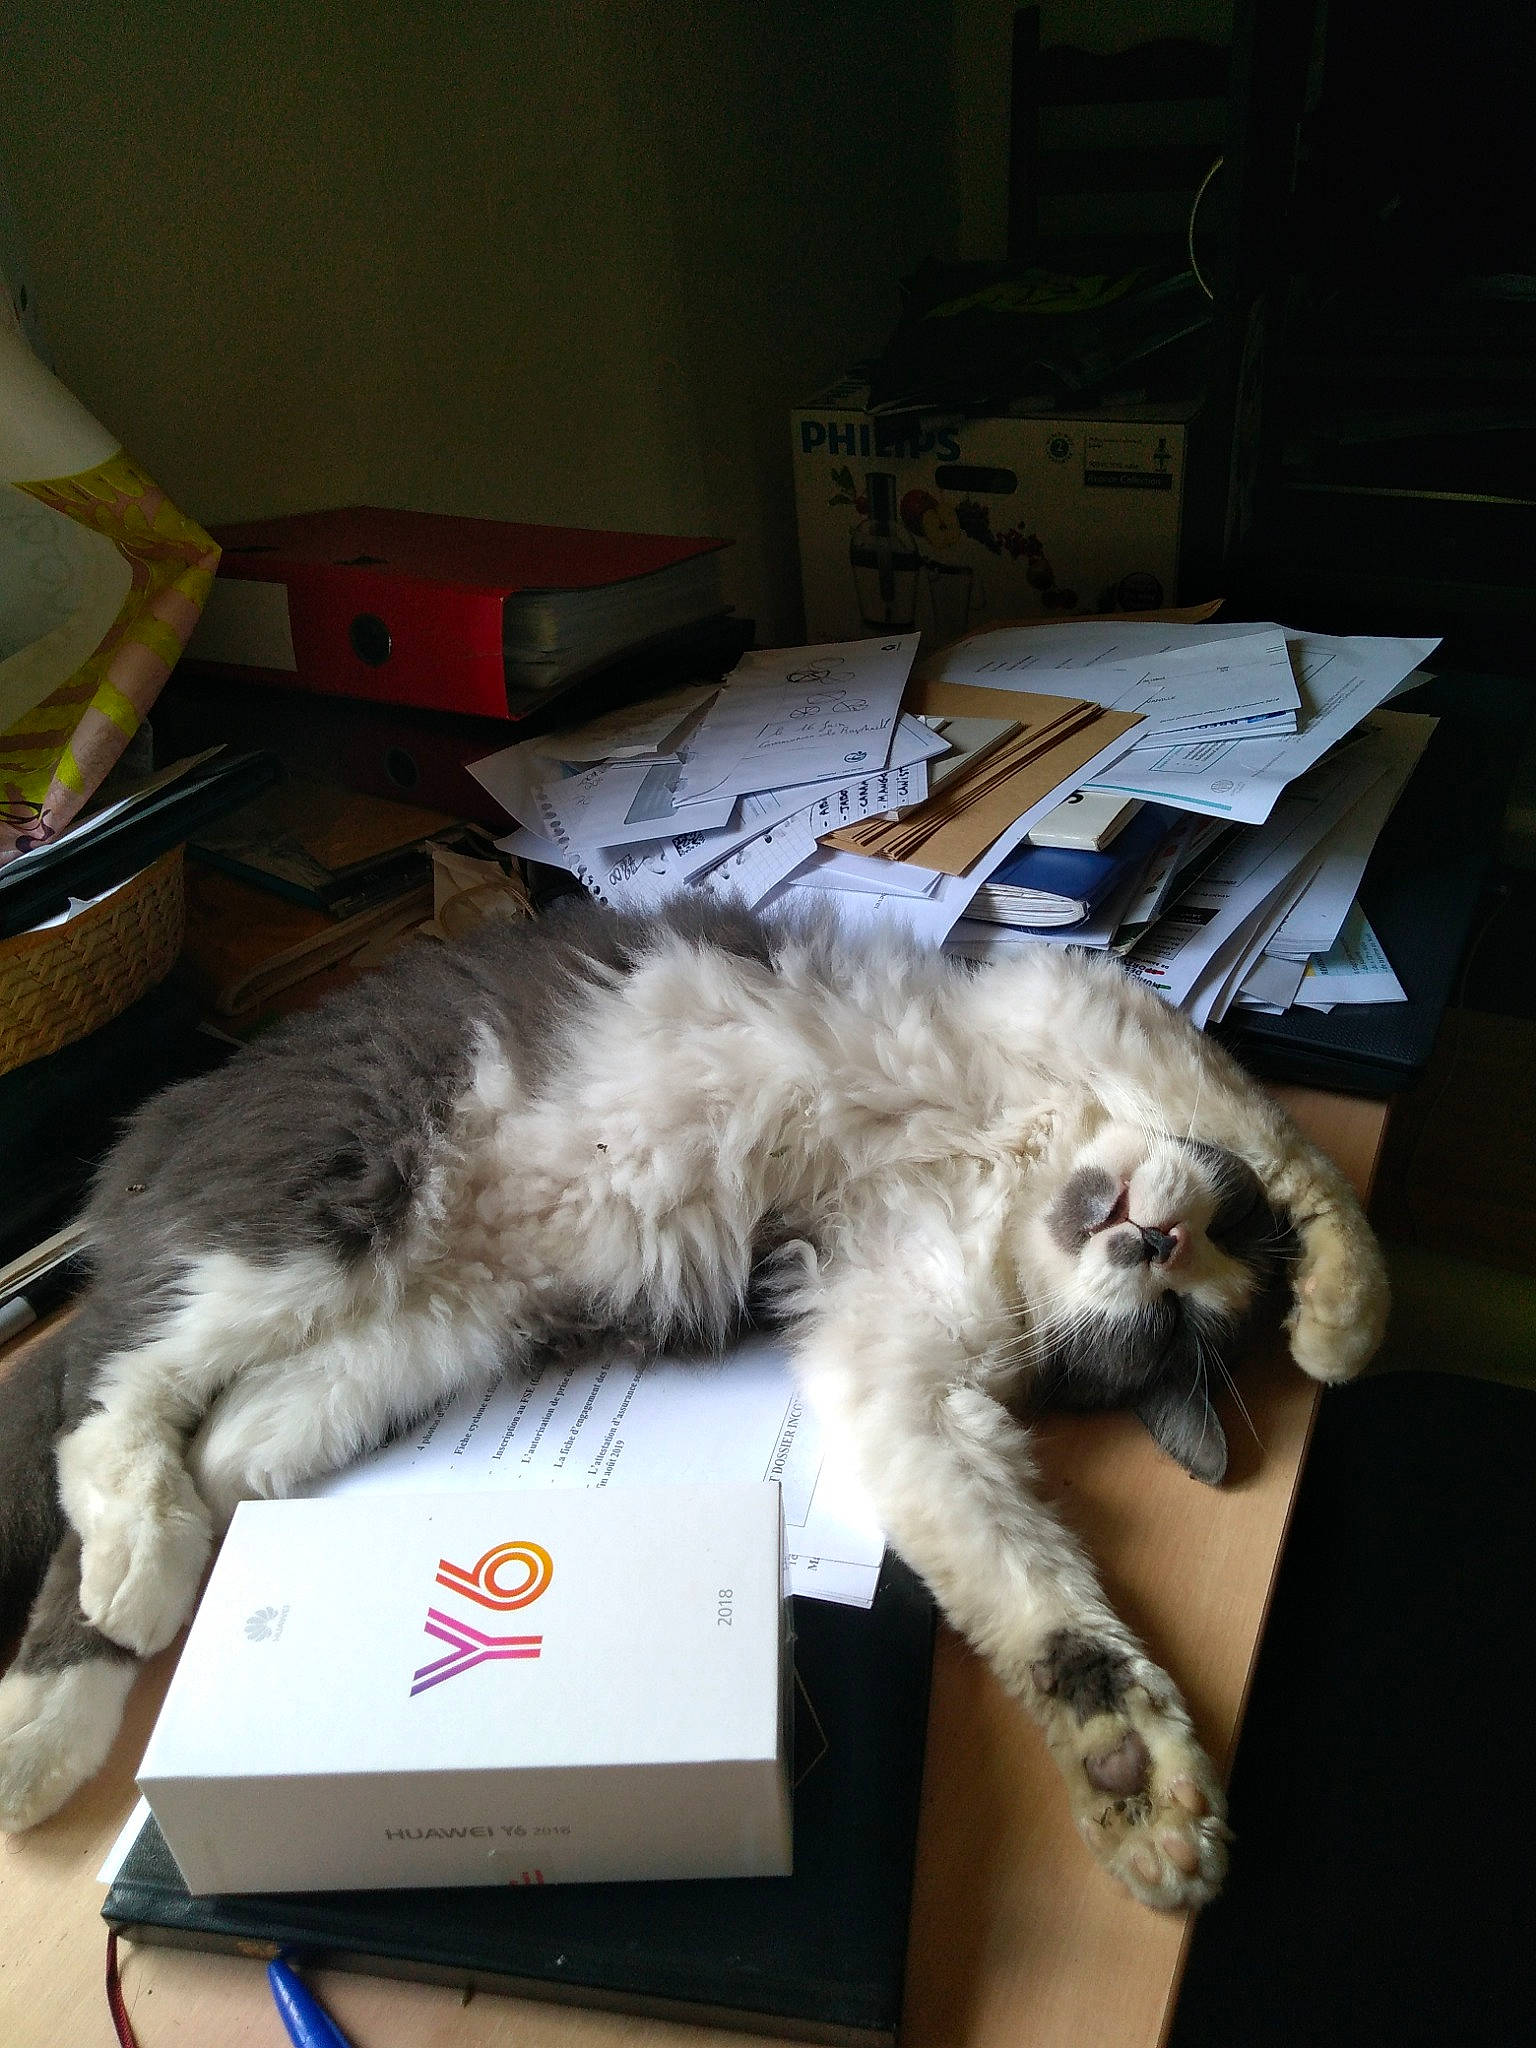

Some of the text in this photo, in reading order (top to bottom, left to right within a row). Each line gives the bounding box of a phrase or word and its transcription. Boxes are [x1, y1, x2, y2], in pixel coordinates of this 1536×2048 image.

[453, 1433, 473, 1456] Fiche
[468, 1402, 489, 1433] cyclone
[568, 1383, 603, 1437] d'engagement
[587, 1426, 619, 1476] L'attestation
[611, 1382, 640, 1428] d'assurance
[491, 1416, 521, 1461] Inscription
[559, 1434, 577, 1456] fiche
[612, 1439, 626, 1459] 2019
[772, 1429, 797, 1476] DOSSIER
[553, 1455, 567, 1469] La
[409, 1540, 554, 1699] Y6
[716, 1587, 735, 1627] 2018
[384, 1825, 572, 1841] HUAWEI Y6 2018
